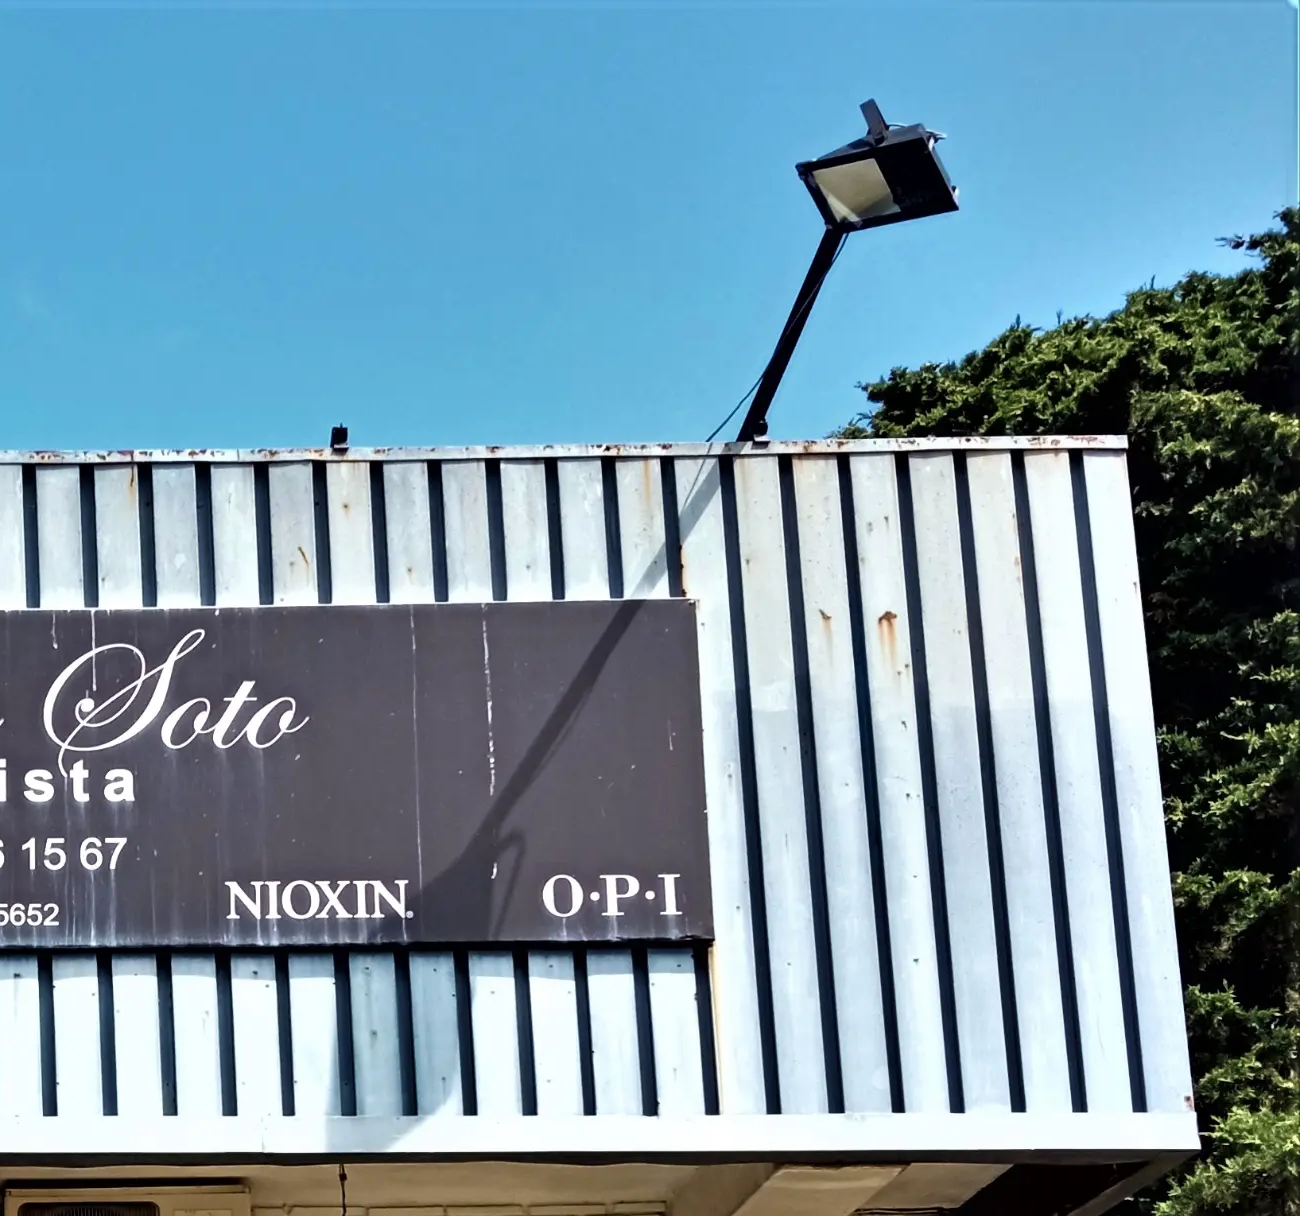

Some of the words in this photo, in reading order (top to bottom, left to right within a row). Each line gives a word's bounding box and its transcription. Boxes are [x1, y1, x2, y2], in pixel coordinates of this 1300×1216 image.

[43, 629, 308, 779] Soto
[21, 837, 67, 871] 15
[79, 836, 128, 871] 67
